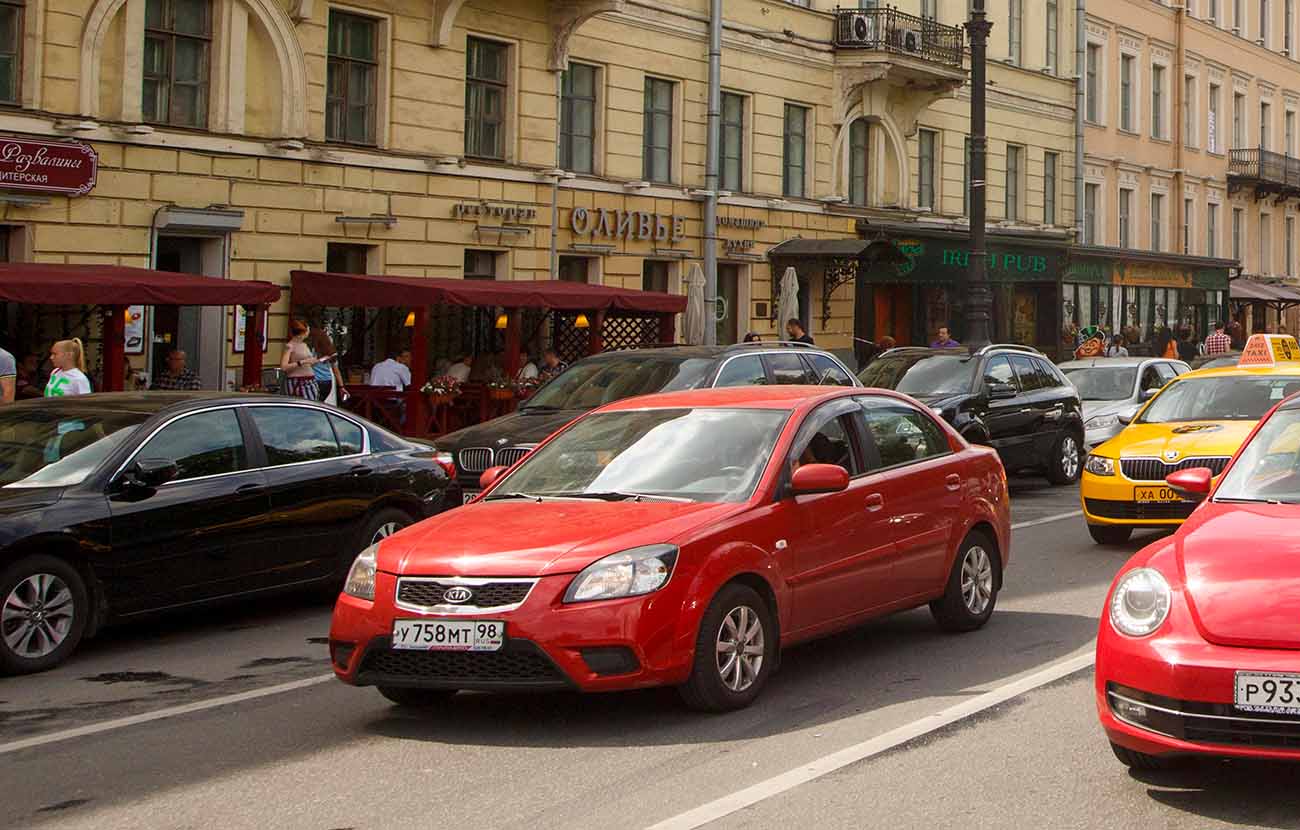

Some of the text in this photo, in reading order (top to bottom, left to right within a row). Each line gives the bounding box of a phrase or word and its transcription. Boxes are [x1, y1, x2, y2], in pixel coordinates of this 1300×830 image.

[571, 207, 688, 243] ОЛИВЬЕ
[1003, 252, 1047, 272] PUB
[447, 590, 467, 600] KIA
[477, 623, 497, 639] 98
